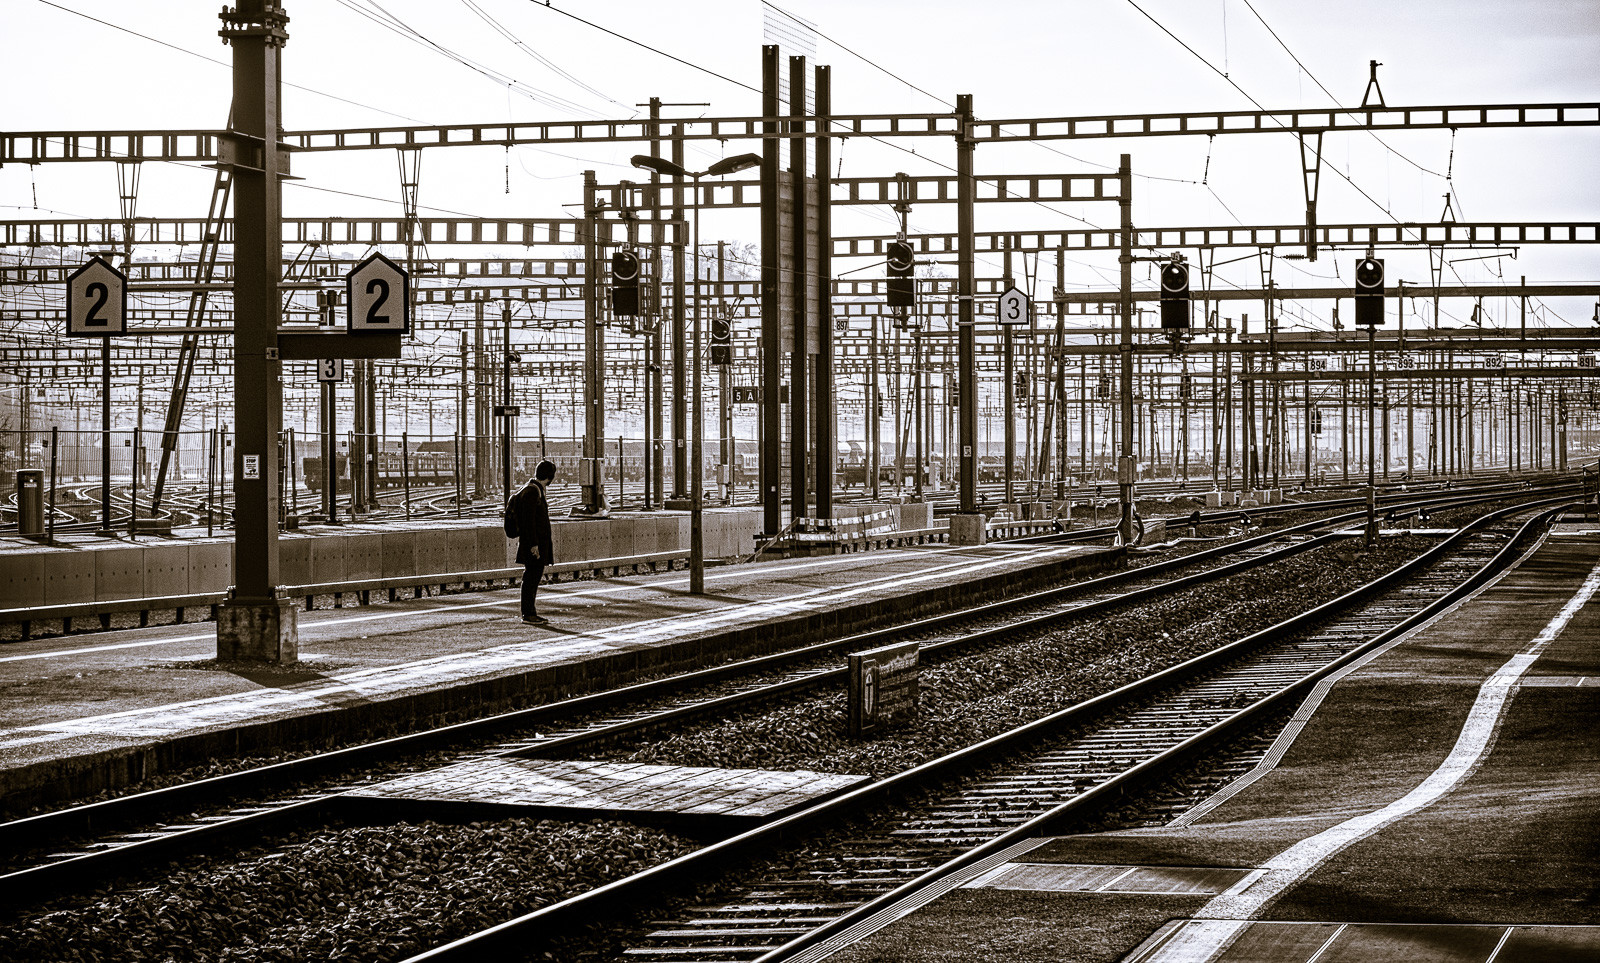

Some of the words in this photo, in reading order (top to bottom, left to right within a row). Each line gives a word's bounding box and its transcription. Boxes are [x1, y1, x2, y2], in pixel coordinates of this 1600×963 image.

[85, 282, 108, 326] 2
[366, 279, 390, 323] 2
[1008, 298, 1020, 319] 3
[836, 321, 848, 330] 897
[1310, 360, 1326, 370] 894
[1398, 359, 1414, 368] 893
[1486, 358, 1502, 367] 892
[1580, 358, 1594, 366] 891
[325, 359, 336, 378] 3
[736, 392, 741, 400] 5
[748, 392, 754, 400] A
